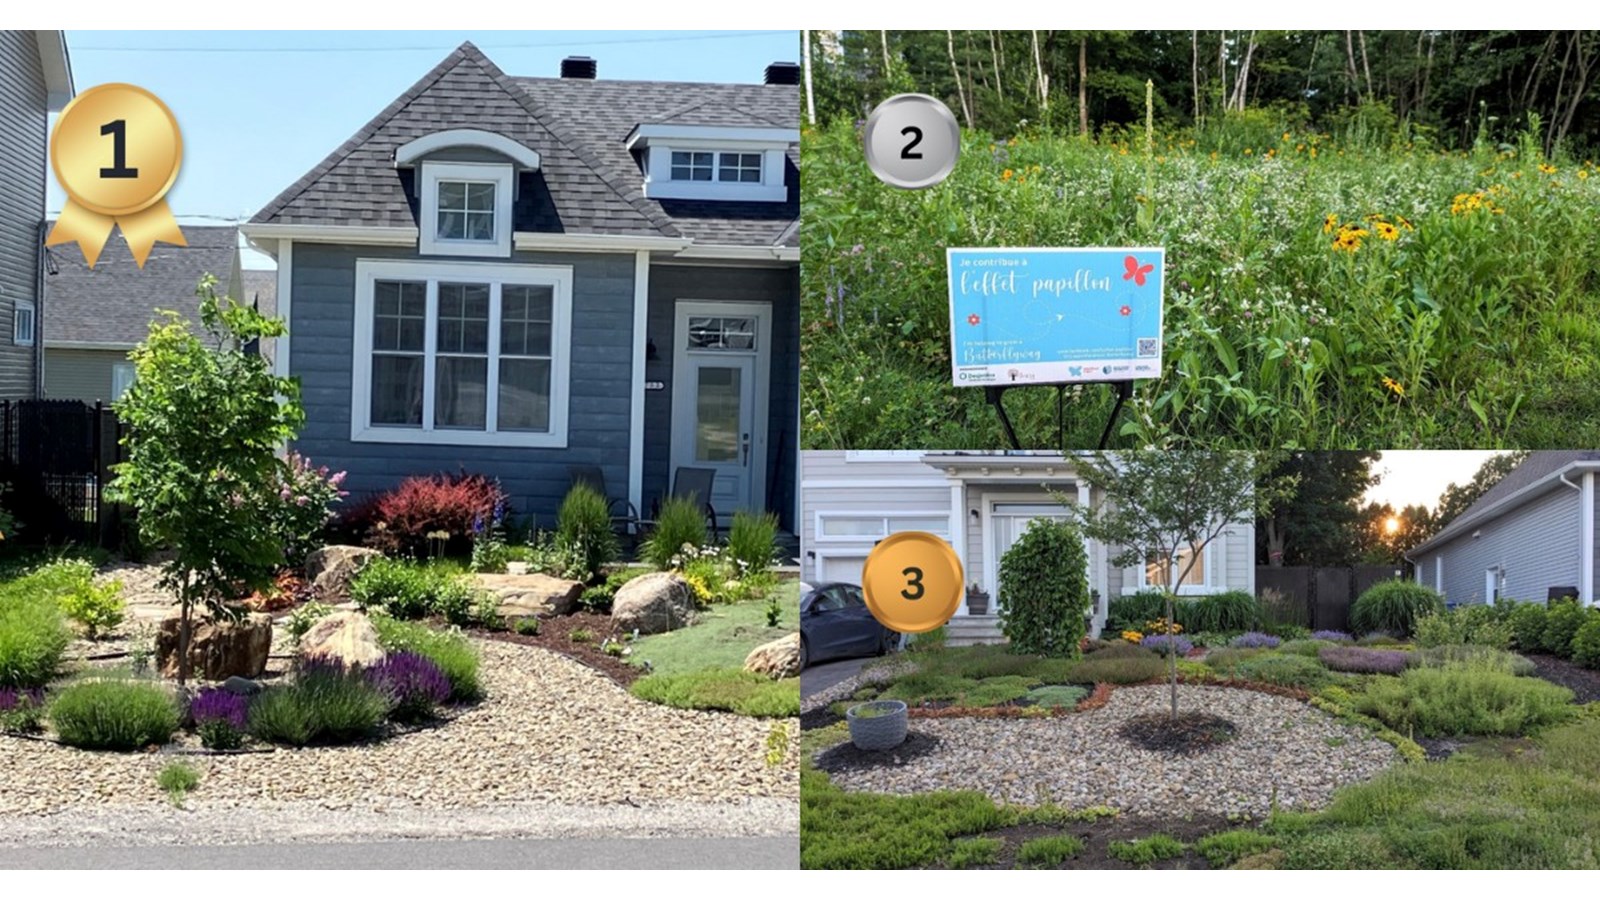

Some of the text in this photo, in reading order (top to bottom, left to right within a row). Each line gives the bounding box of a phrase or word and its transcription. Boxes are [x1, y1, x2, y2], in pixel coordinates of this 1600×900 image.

[959, 258, 971, 267] Je
[973, 257, 1019, 267] contribue
[960, 268, 1110, 298] l'effet papillon
